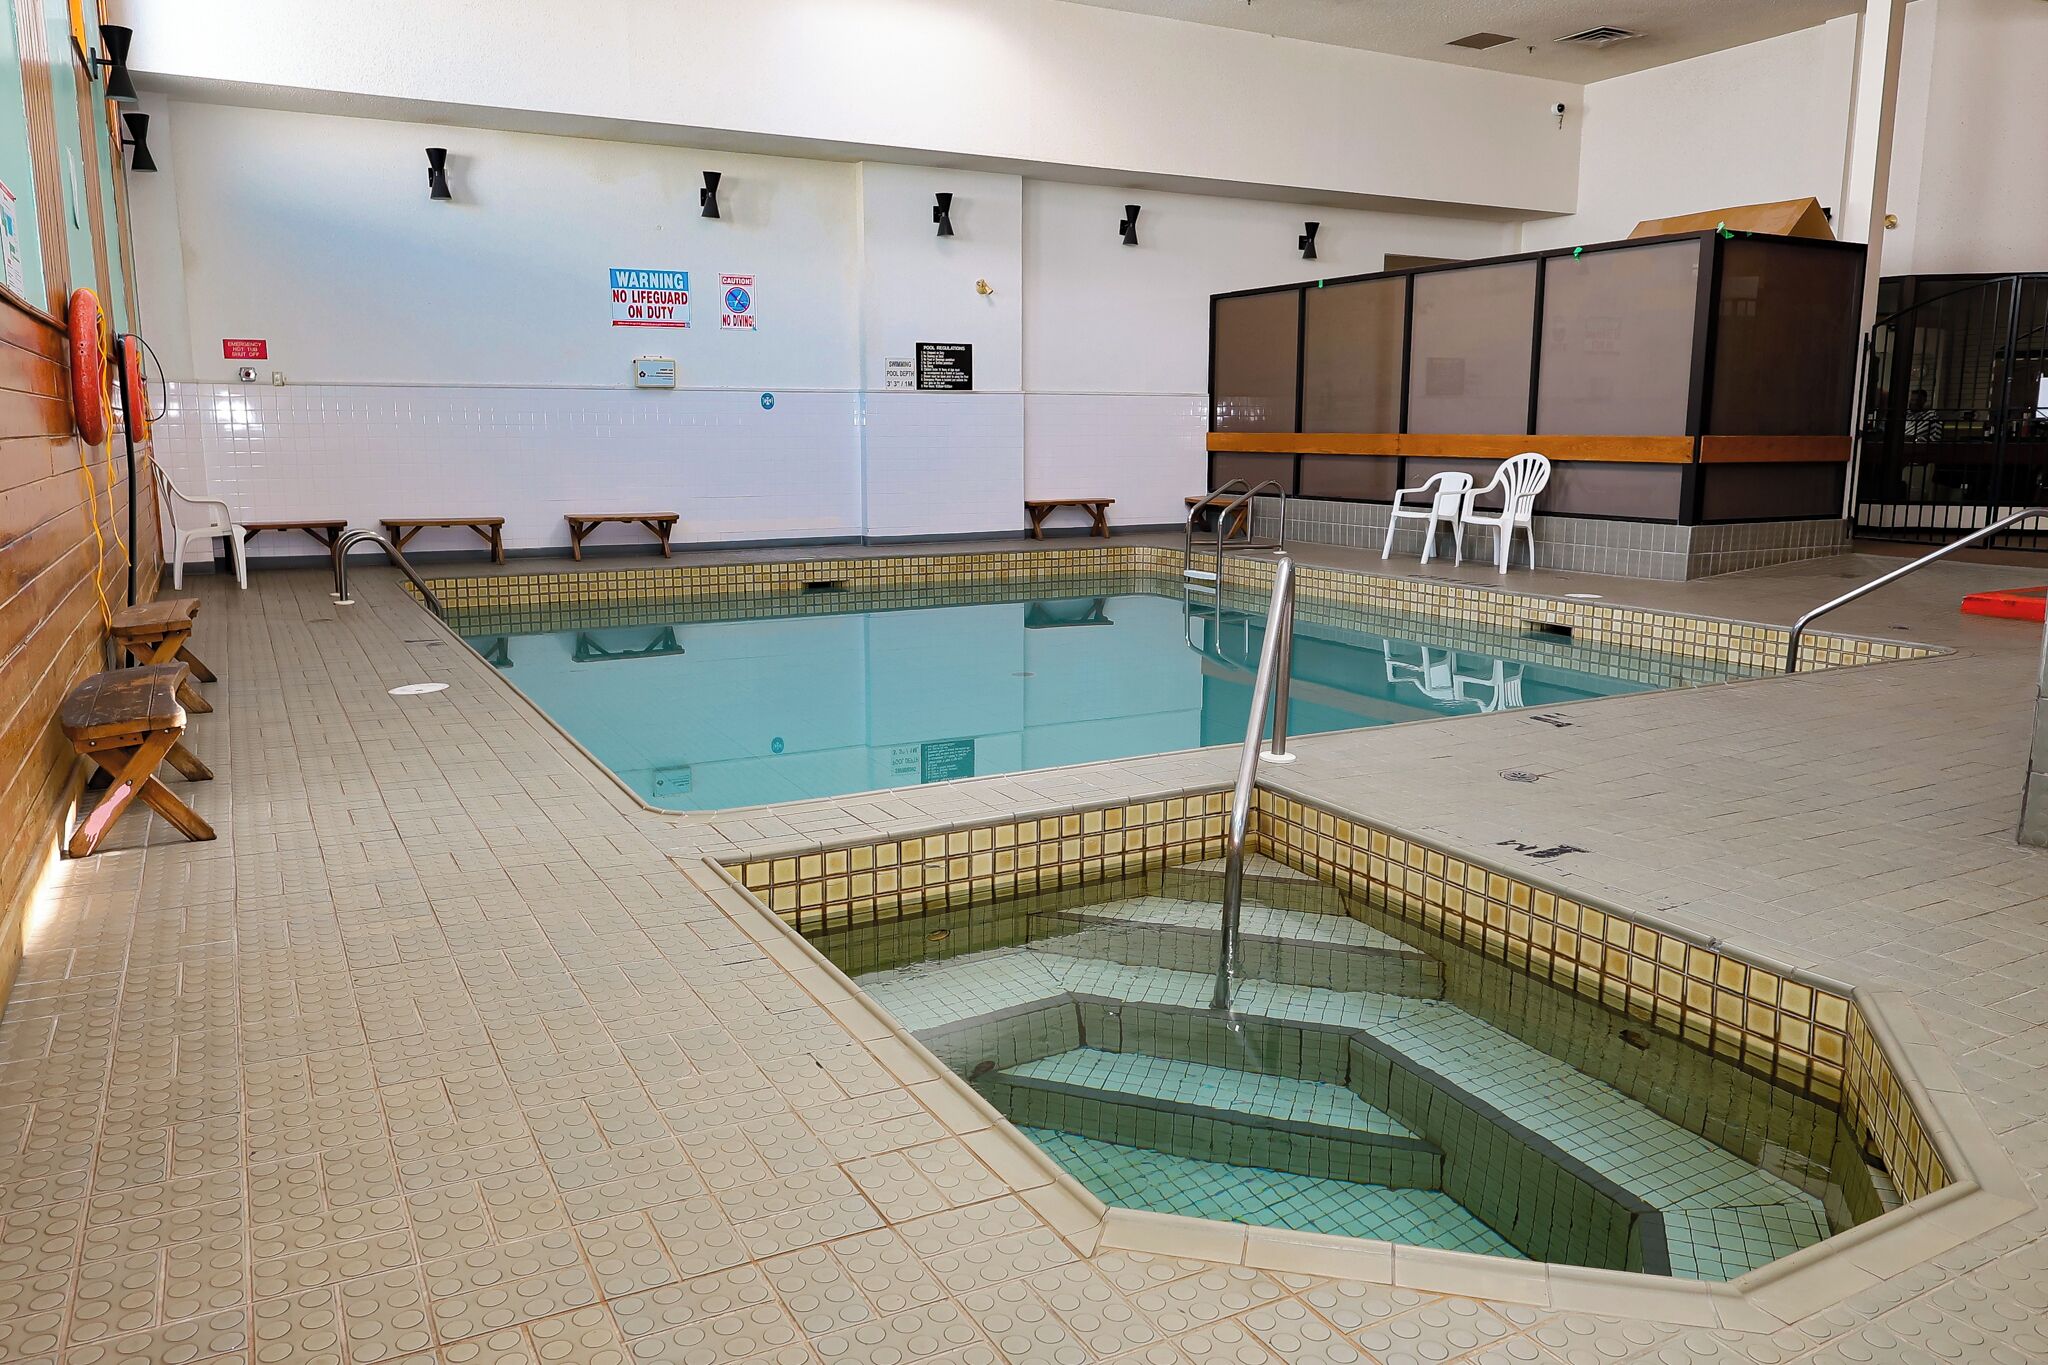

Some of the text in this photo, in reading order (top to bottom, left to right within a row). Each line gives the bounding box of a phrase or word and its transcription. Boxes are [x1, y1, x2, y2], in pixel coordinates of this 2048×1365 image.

[616, 271, 684, 289] WARNING
[722, 277, 752, 285] CAUTION!
[612, 289, 688, 305] NO LIFEGUARD
[628, 304, 674, 319] ON DUTY
[722, 314, 754, 327] NO DIVING!
